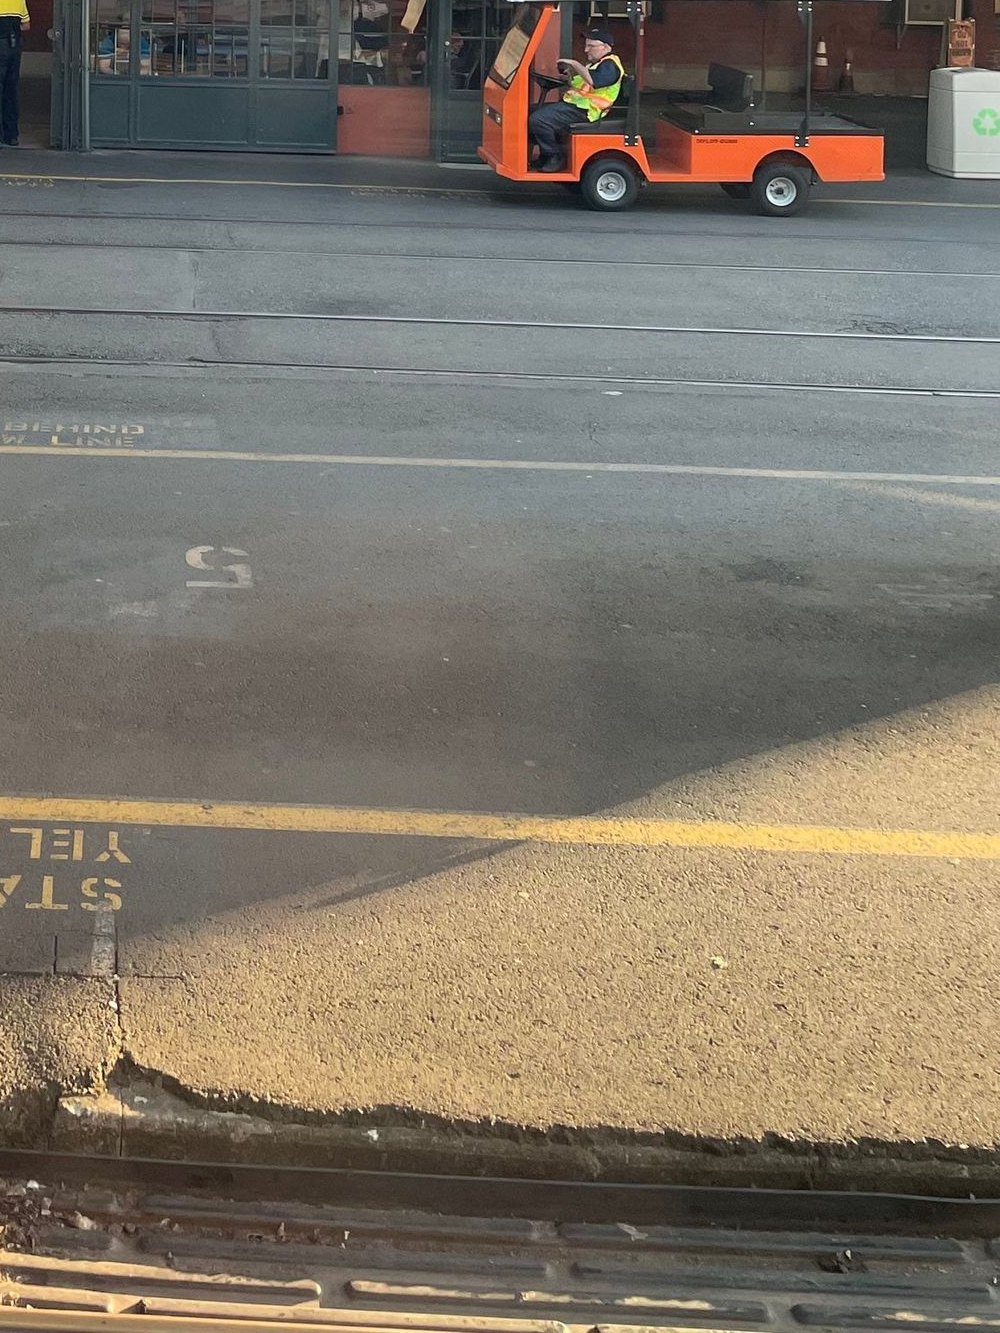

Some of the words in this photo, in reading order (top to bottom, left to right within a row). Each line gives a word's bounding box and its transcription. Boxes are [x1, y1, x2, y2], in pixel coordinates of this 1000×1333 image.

[4, 421, 145, 435] BEHIND
[50, 434, 135, 448] LINE
[185, 545, 254, 588] 5
